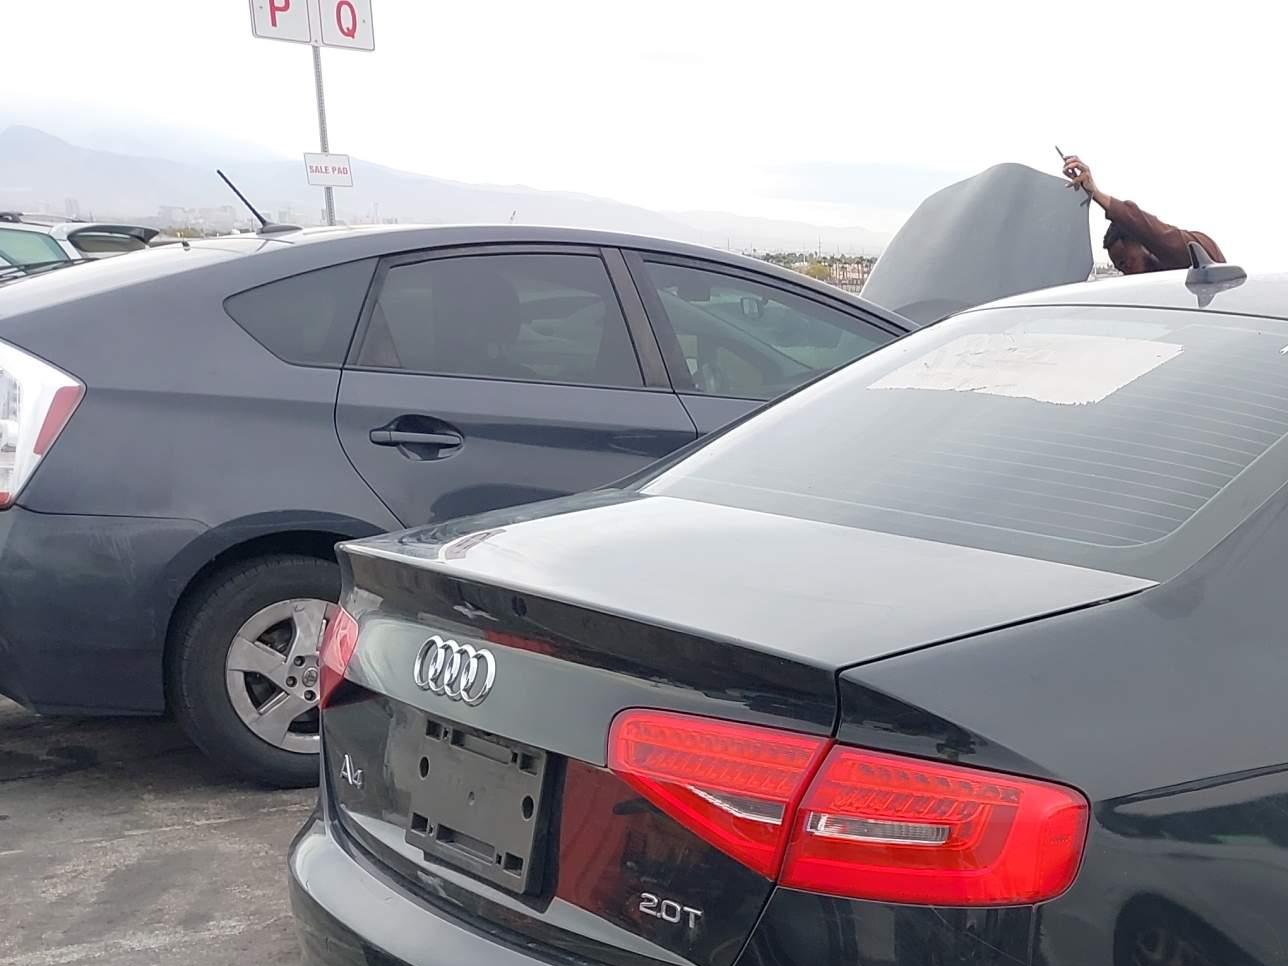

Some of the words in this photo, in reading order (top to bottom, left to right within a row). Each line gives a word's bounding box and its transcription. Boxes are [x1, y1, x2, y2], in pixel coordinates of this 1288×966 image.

[269, 0, 290, 27] P
[336, 0, 357, 39] Q
[309, 165, 330, 174] SALE
[331, 166, 349, 175] PAD
[340, 754, 362, 790] A4
[639, 892, 703, 929] 2.0T
